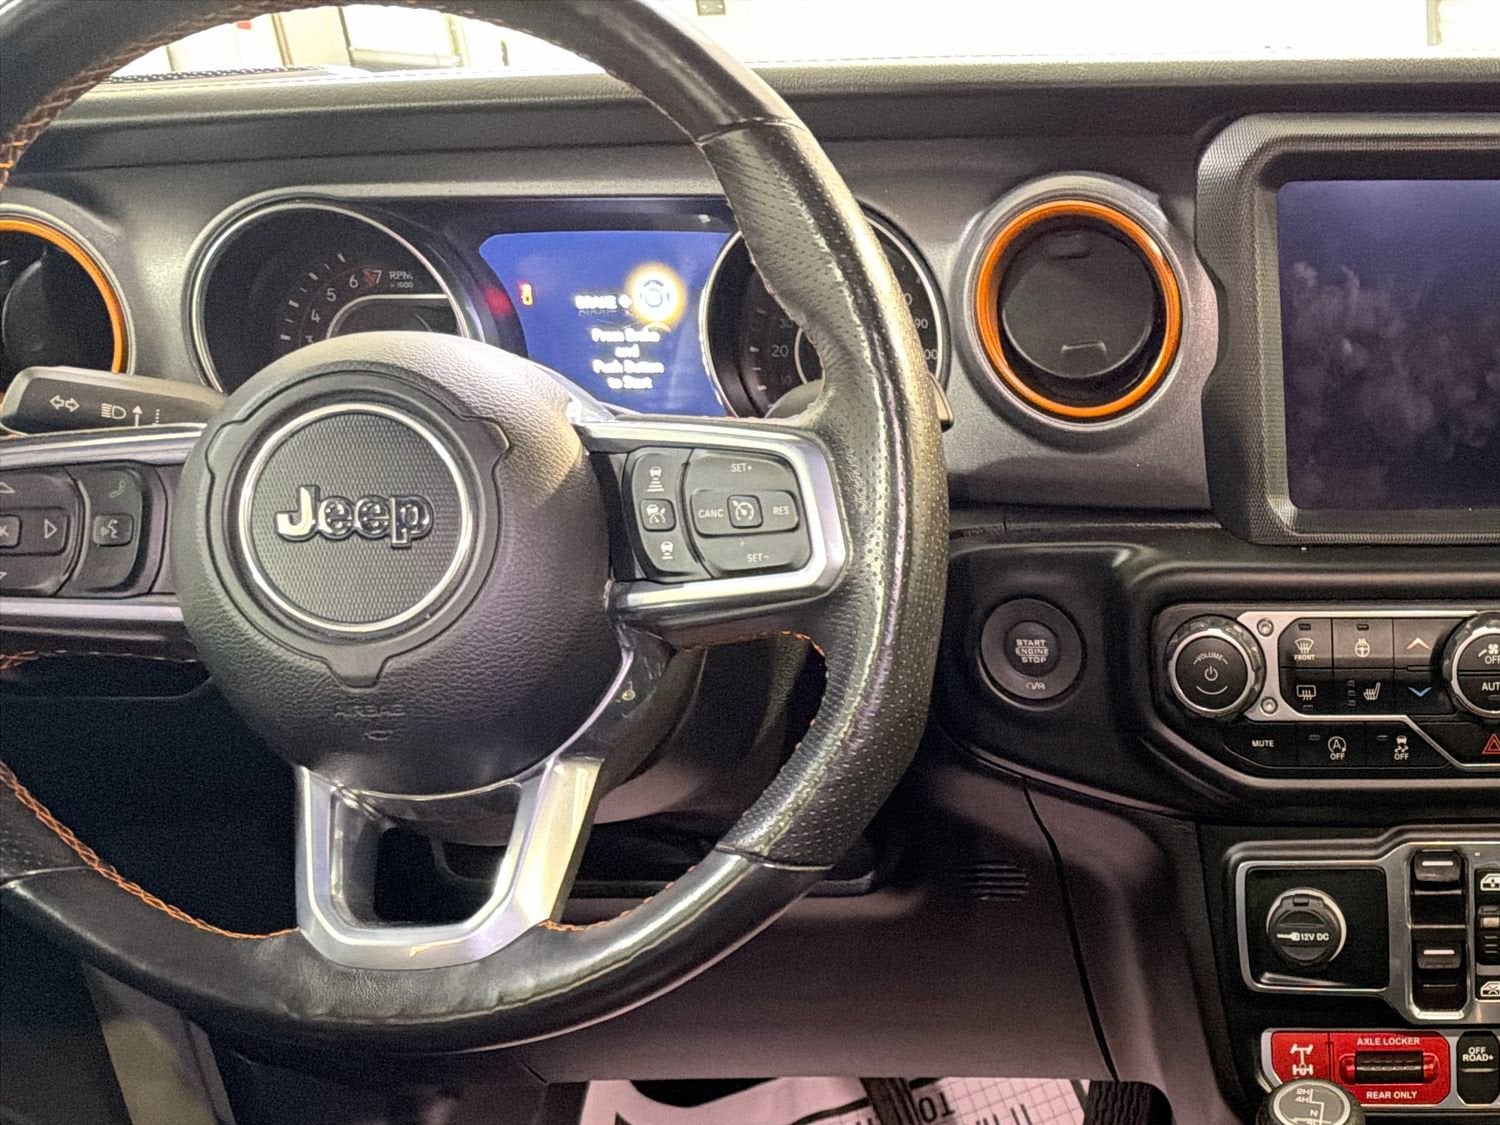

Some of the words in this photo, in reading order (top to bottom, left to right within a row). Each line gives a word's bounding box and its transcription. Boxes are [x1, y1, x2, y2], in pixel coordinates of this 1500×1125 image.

[349, 274, 359, 288] 6
[372, 269, 382, 284] 7
[326, 287, 337, 302] 5
[311, 308, 321, 323] 4
[771, 344, 790, 358] 20
[698, 508, 725, 519] CANC
[772, 505, 790, 516] RES
[276, 484, 435, 549] Jeep
[1016, 639, 1047, 647] START
[1021, 656, 1047, 664] STOP
[1196, 652, 1224, 662] VOLUME
[1252, 740, 1275, 748] MUTE
[1330, 753, 1346, 761] OFF
[1394, 753, 1410, 761] OFF
[1300, 932, 1315, 941] 12V
[1316, 932, 1330, 941] DC
[1357, 1037, 1381, 1046] AXLE
[1382, 1036, 1420, 1046] LOCKER
[1468, 1046, 1486, 1055] OFF
[1295, 1096, 1309, 1104] 4H
[1366, 1091, 1392, 1100] REAR
[1393, 1090, 1418, 1100] ONLY
[919, 1088, 955, 1123] TO
[1309, 1109, 1318, 1117] N
